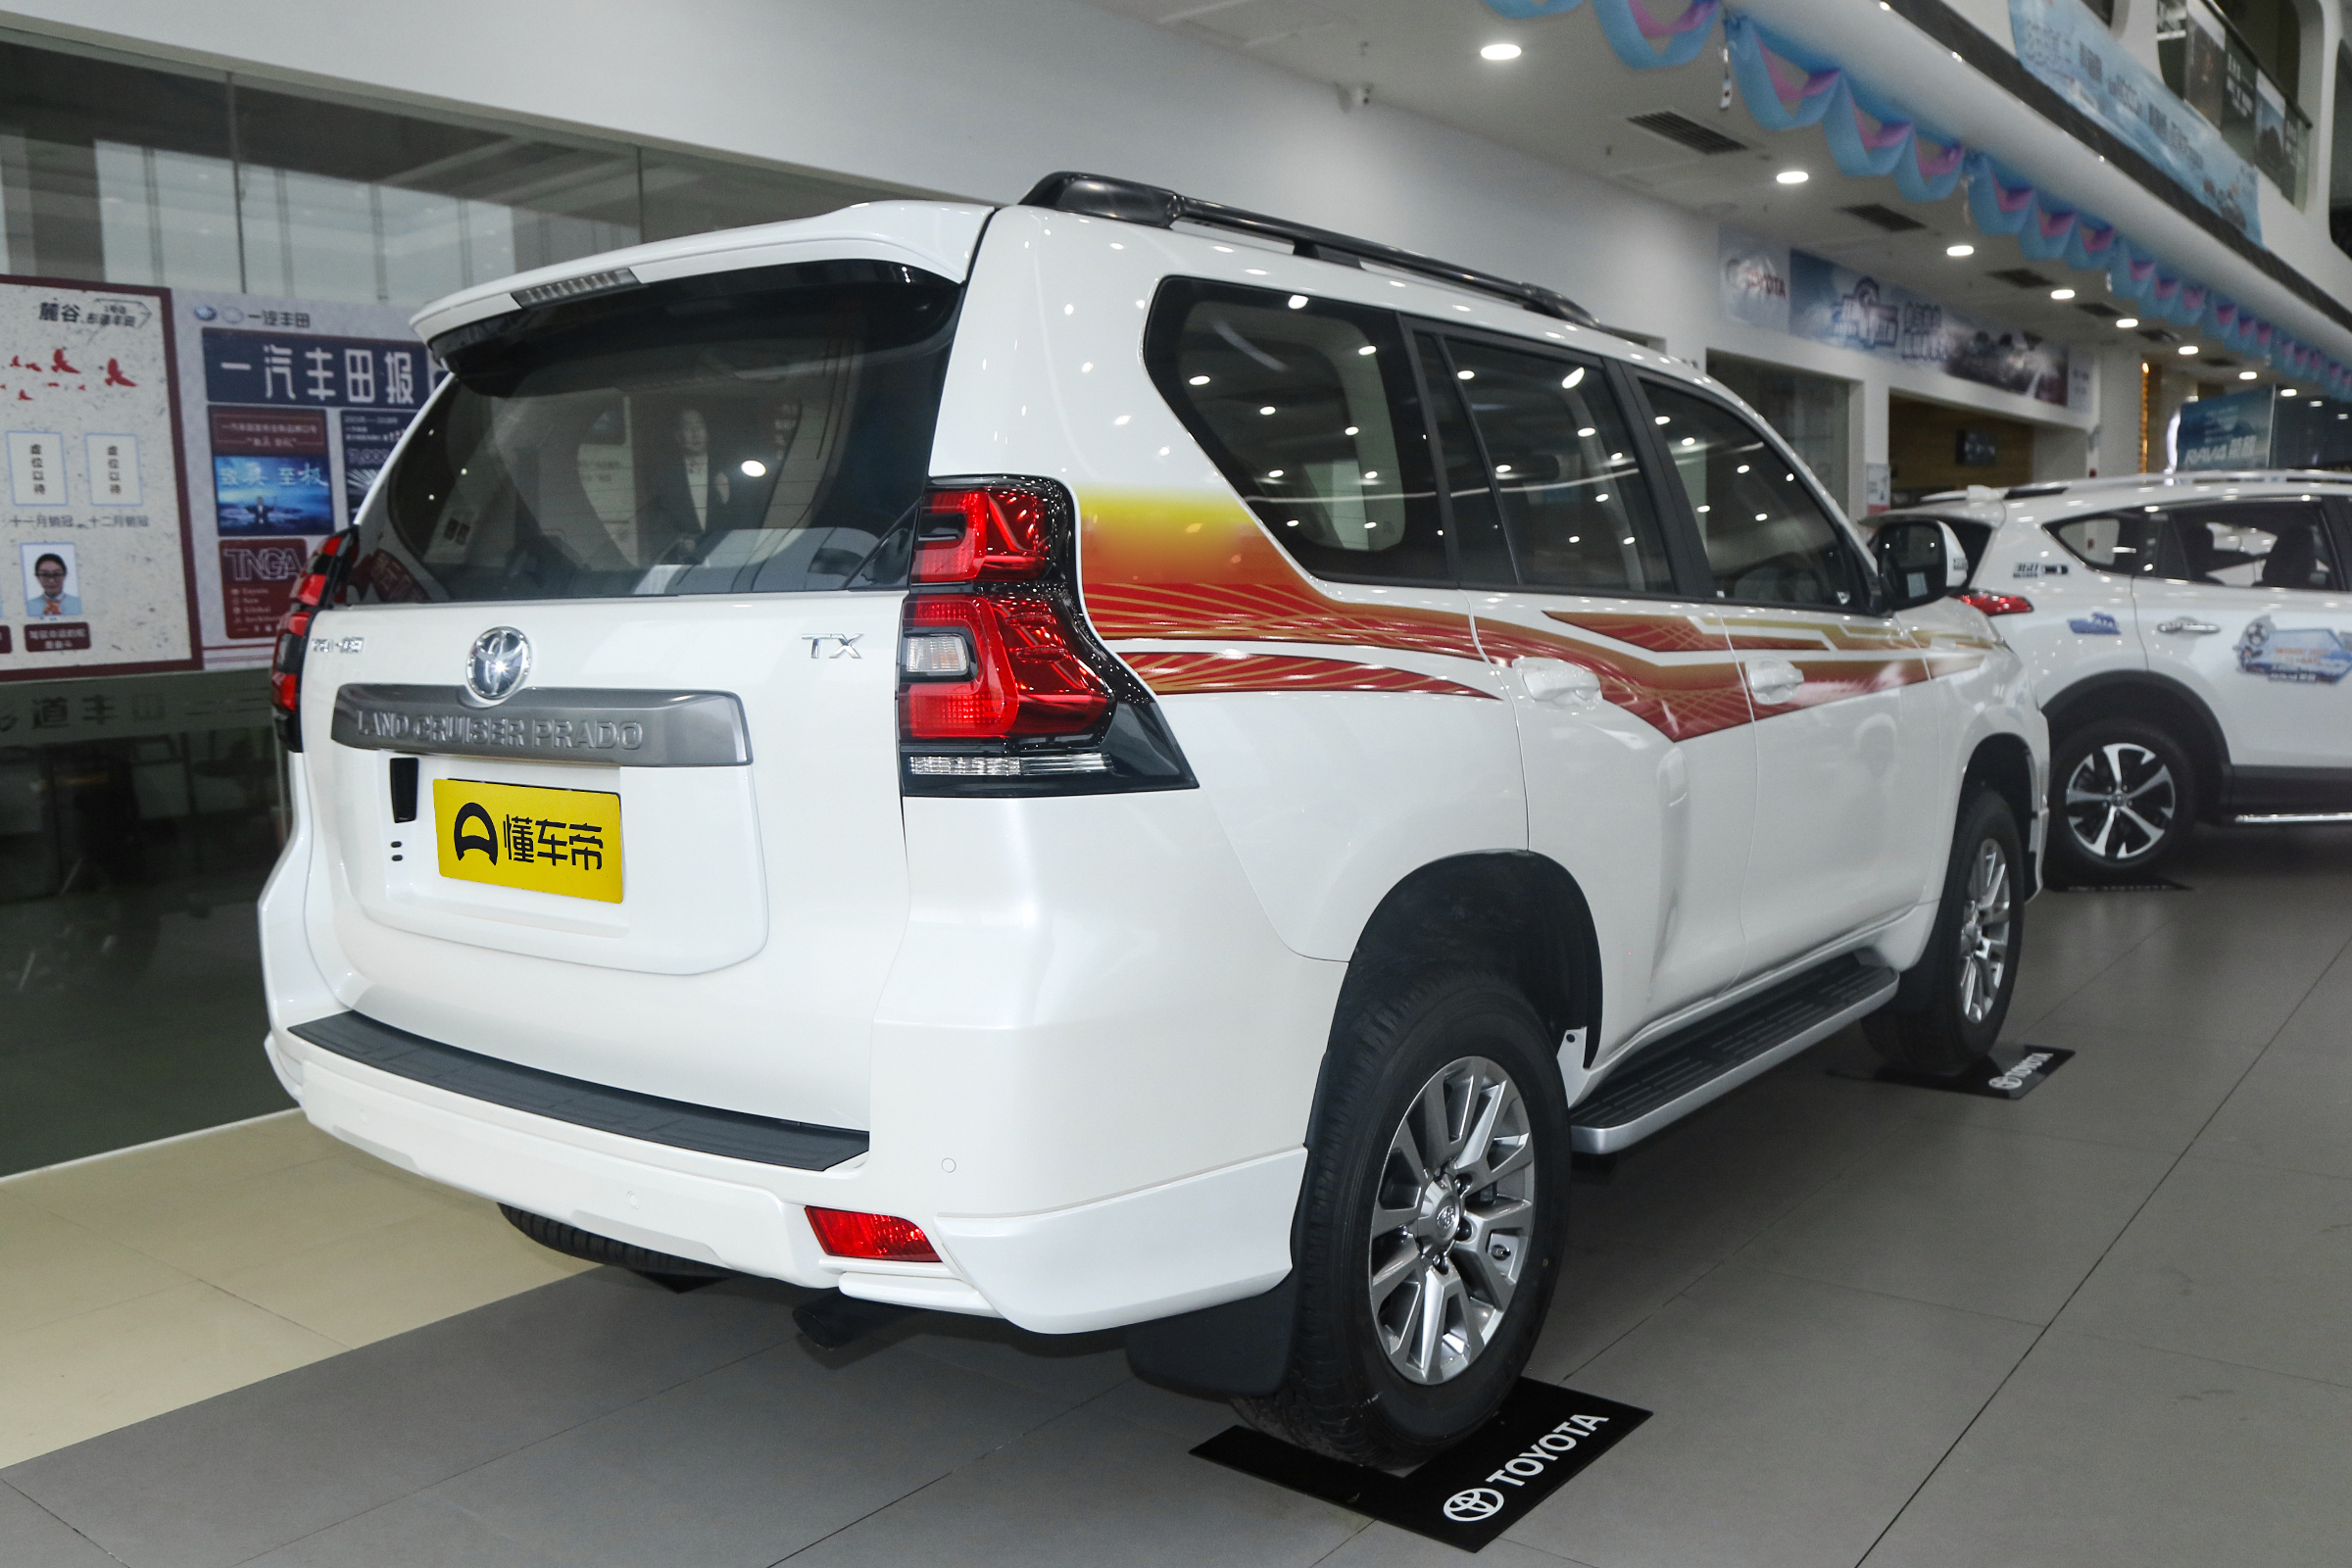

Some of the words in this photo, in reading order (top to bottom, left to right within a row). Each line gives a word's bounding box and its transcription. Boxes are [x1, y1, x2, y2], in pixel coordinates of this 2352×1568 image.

[248, 310, 311, 328] 一汽丰田
[220, 344, 415, 405] 一汽丰田报
[223, 548, 302, 581] TNGA
[801, 633, 864, 660] TX
[357, 710, 410, 737] LAND
[413, 714, 525, 748] CRUISER
[532, 718, 644, 751] PRADO
[503, 813, 604, 870] 懂车帝
[1485, 1413, 1610, 1488] TOYOTA
